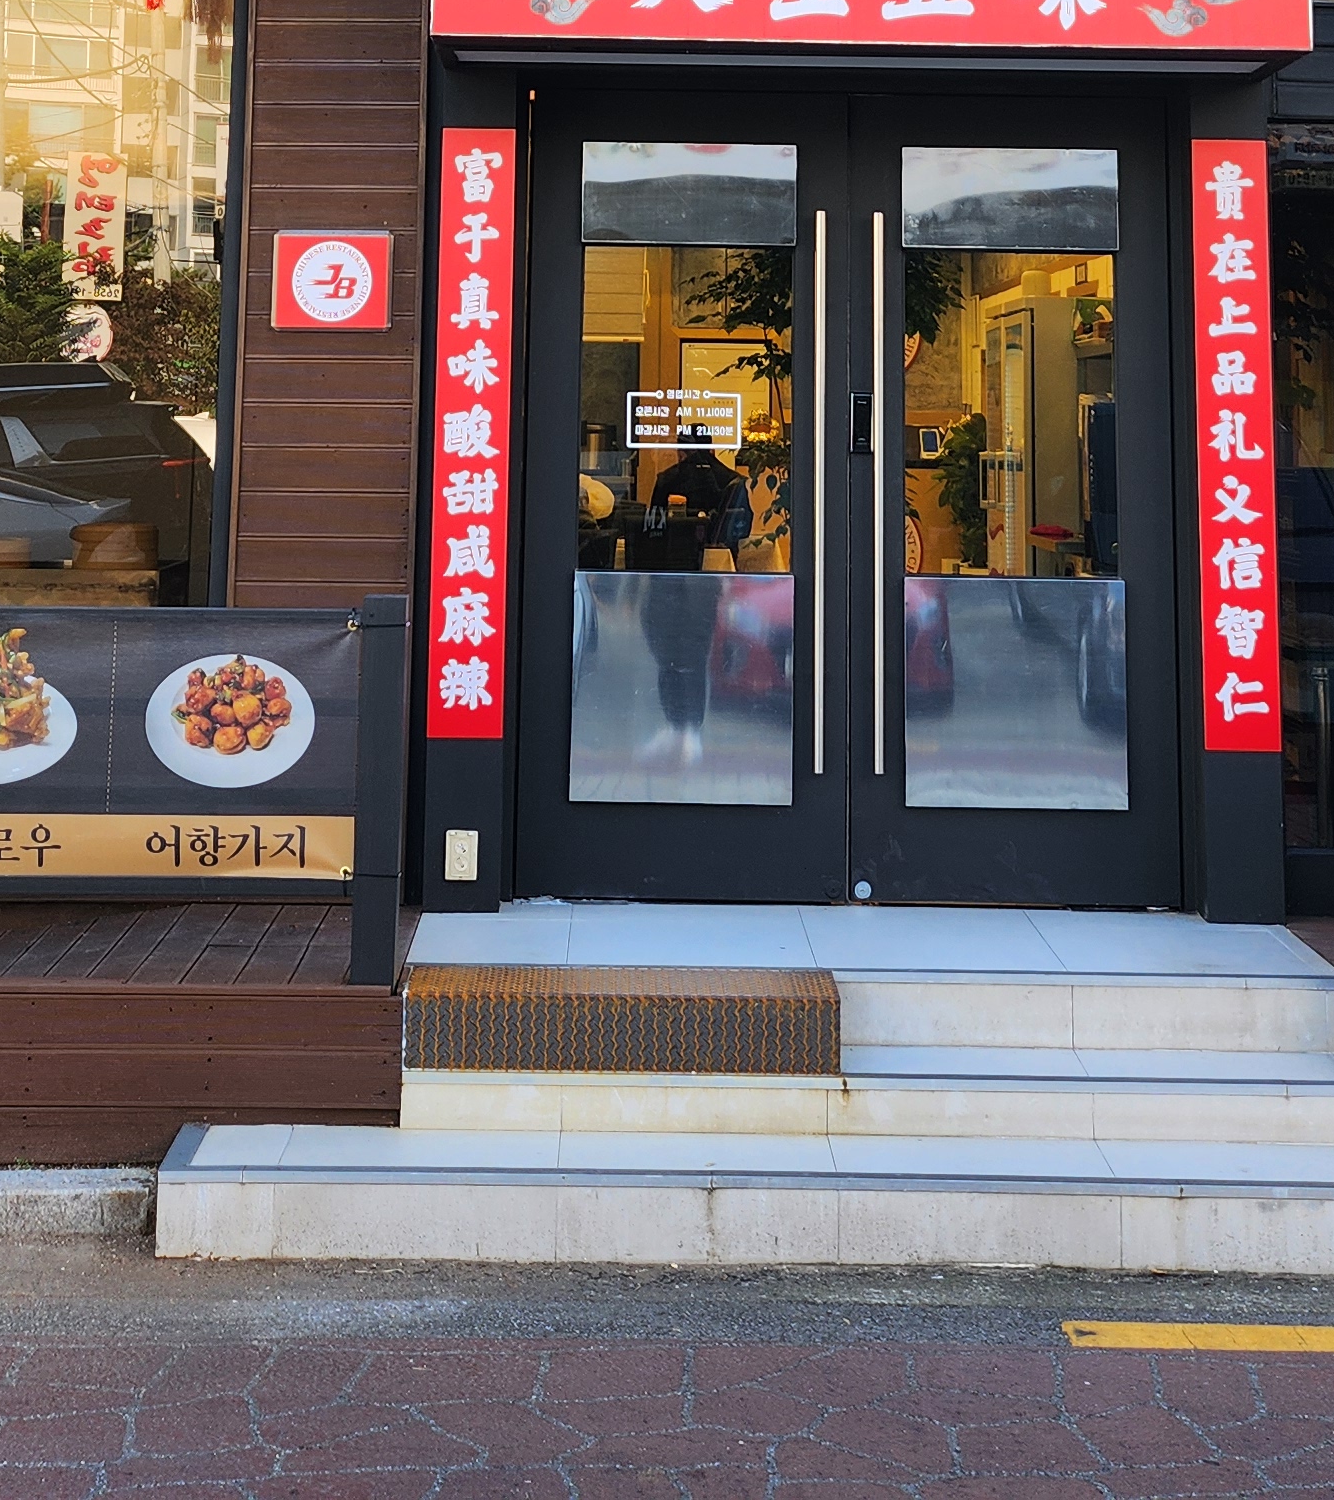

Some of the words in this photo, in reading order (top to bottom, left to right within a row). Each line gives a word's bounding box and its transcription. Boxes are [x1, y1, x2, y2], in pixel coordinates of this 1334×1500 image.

[295, 245, 324, 278] CHINESE
[326, 244, 369, 278] RESTAURANT
[295, 284, 339, 319] RESTAURANT
[341, 286, 369, 315] CHINESE
[676, 407, 692, 417] AM
[677, 425, 692, 436] PM
[144, 823, 308, 871] 어향가지
